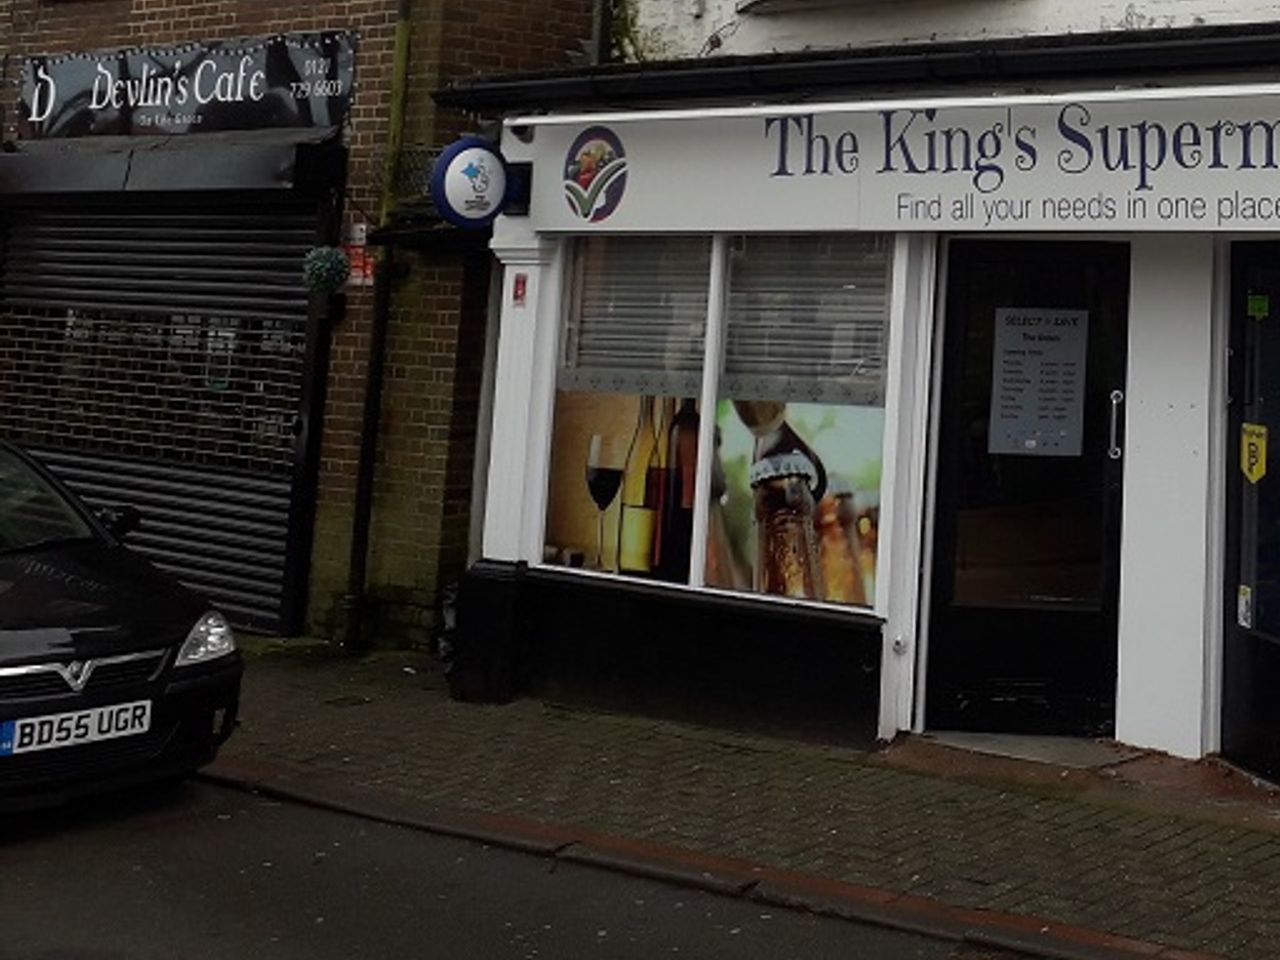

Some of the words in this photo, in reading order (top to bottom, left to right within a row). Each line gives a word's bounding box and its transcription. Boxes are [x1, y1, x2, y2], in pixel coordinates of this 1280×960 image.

[88, 60, 189, 109] Devlin's
[764, 112, 860, 178] The
[876, 107, 1038, 193] King's
[897, 193, 941, 221] Find
[951, 193, 974, 220] all
[983, 198, 1032, 227] your
[1042, 192, 1117, 220] needs
[1127, 190, 1146, 220] in
[1157, 195, 1207, 220] one
[16, 713, 92, 749] BD55
[97, 704, 147, 735] UGR
